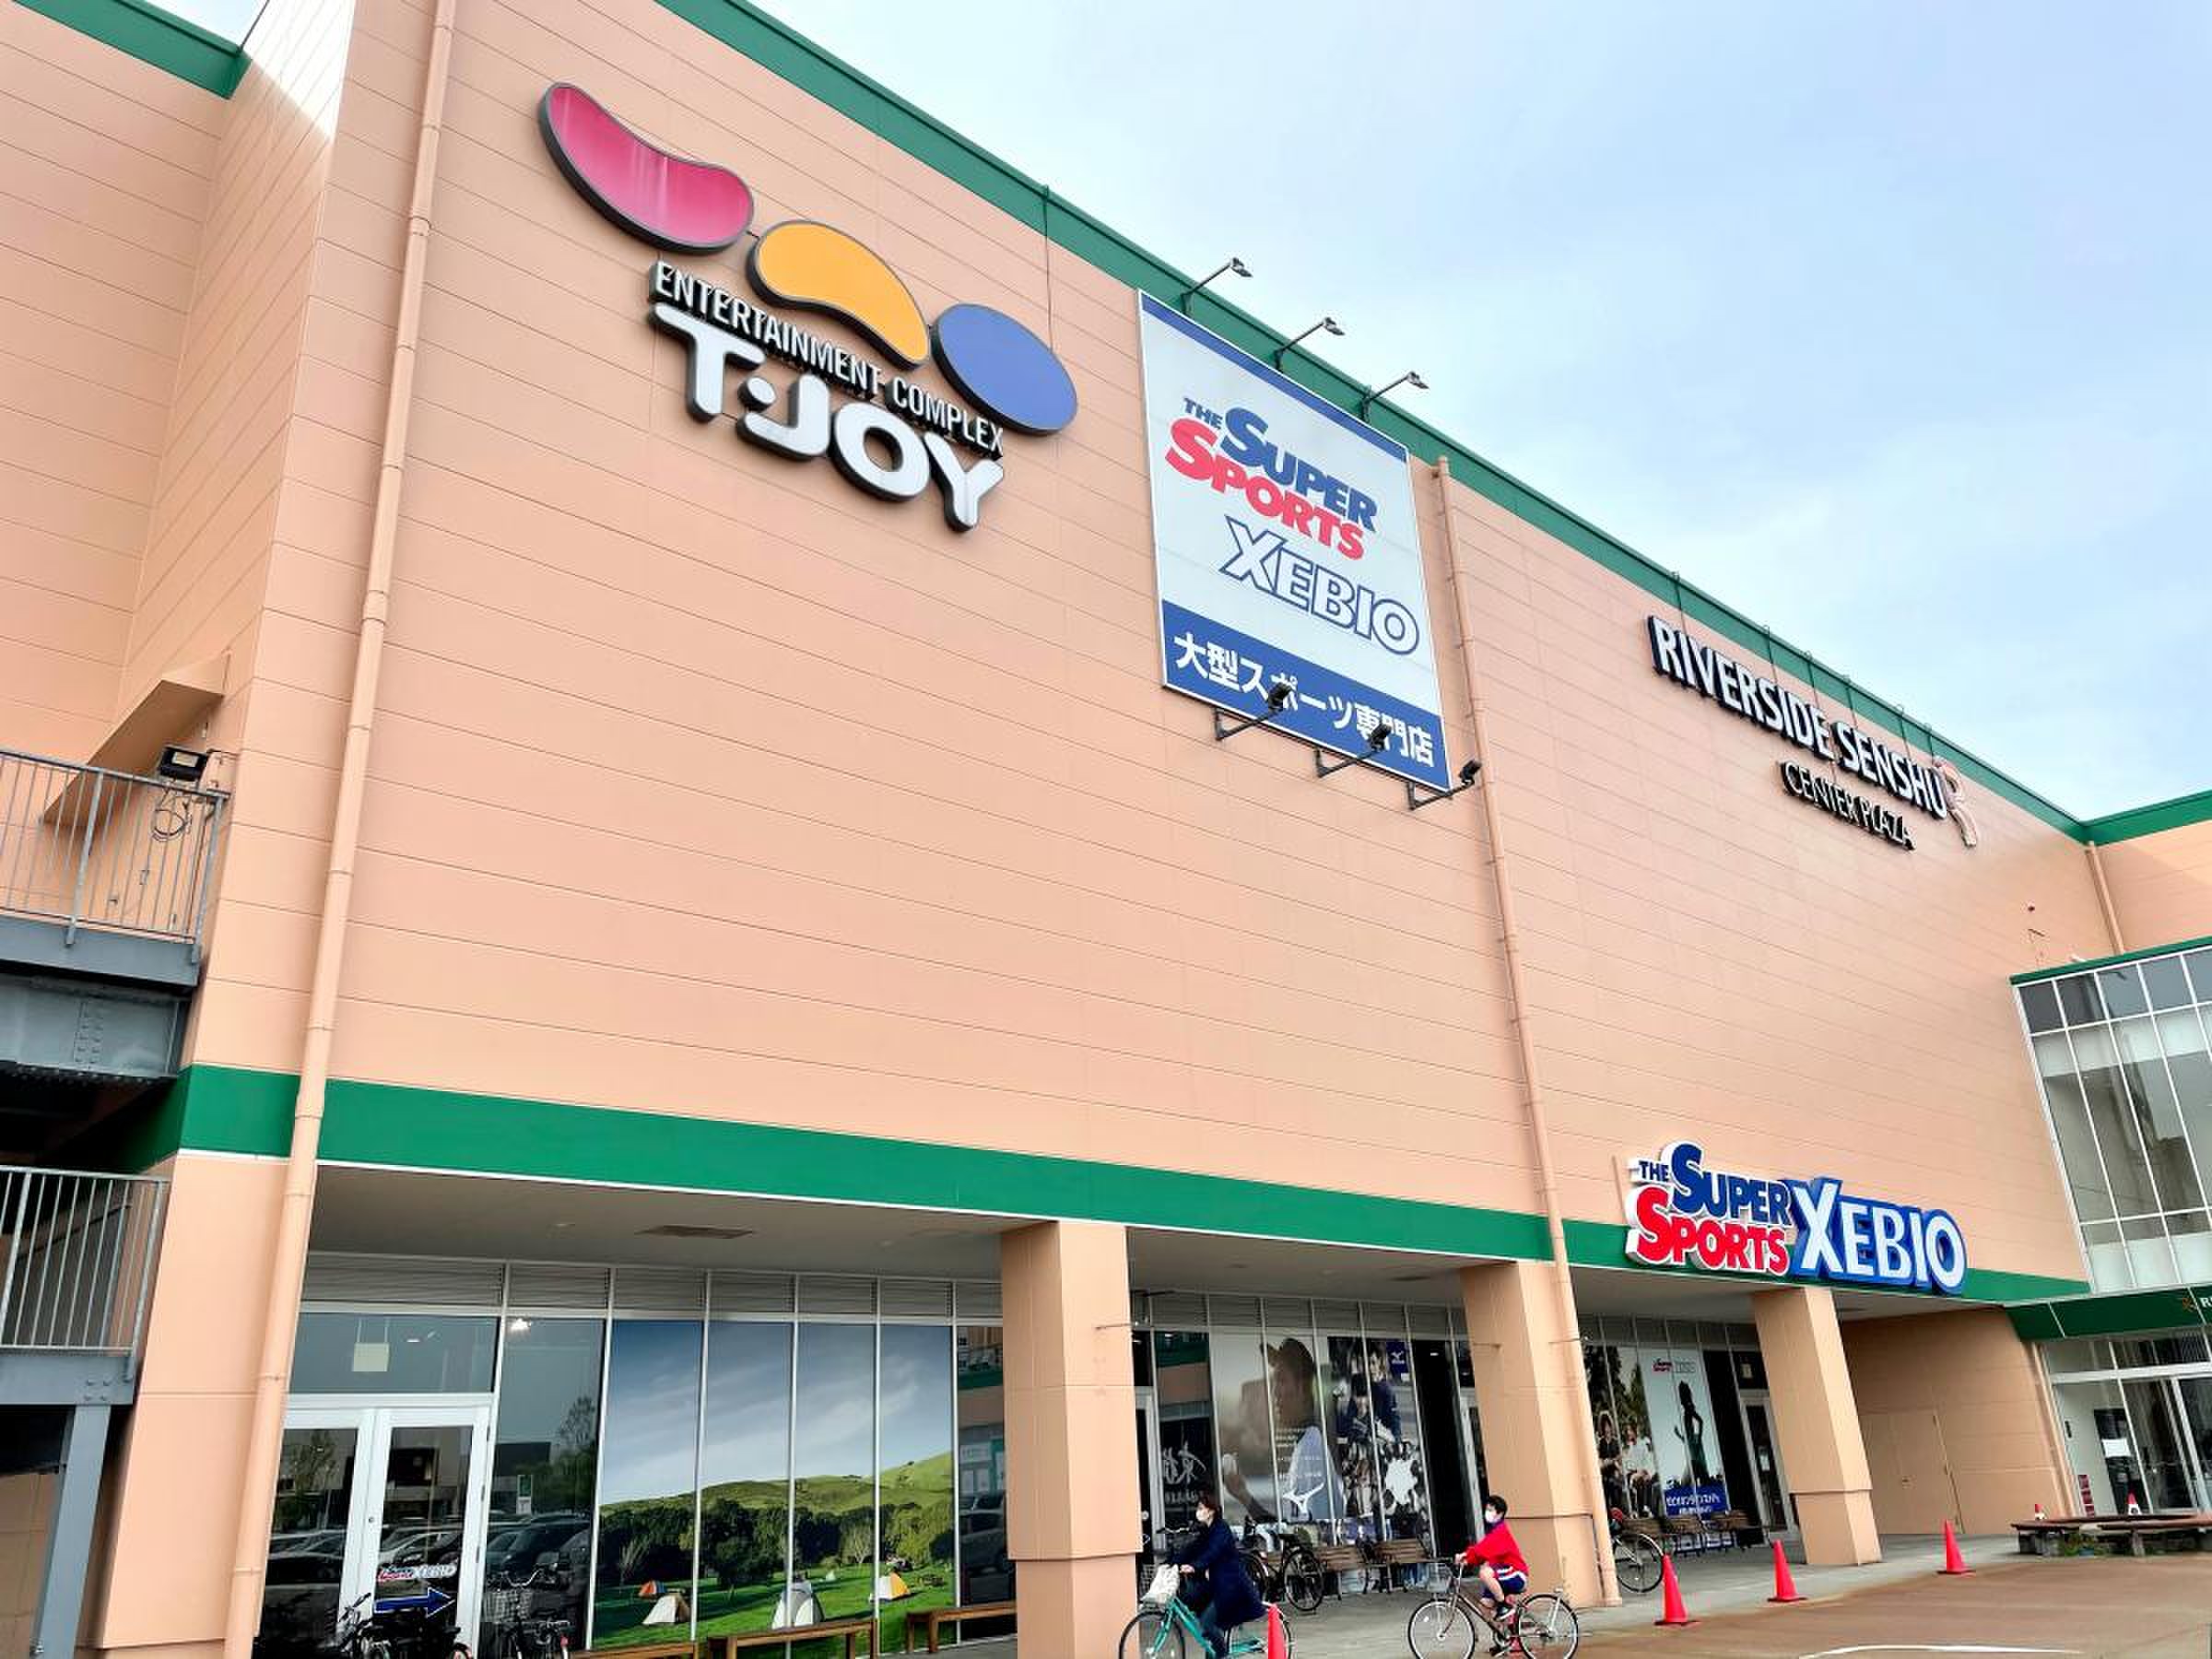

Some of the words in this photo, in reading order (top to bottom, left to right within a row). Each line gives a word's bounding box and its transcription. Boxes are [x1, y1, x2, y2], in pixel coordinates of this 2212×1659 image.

[653, 261, 885, 393] ENTERTAINMENT
[890, 376, 1004, 456] COMPLEX
[1164, 418, 1366, 561] SPORTS
[1182, 397, 1224, 430] THE
[1219, 406, 1378, 533] SUPER
[1218, 513, 1420, 656] XEBIO
[1649, 615, 1834, 760] RIVERSIDE
[1830, 720, 1947, 820] SENSHU
[1783, 760, 1860, 827] CENTER
[1856, 795, 1916, 851] PLAZA
[1635, 1187, 1789, 1277] SPORTS
[1638, 1159, 1670, 1182] THE
[1670, 1142, 1793, 1227] SUPER
[1793, 1178, 1966, 1290] XEBIO
